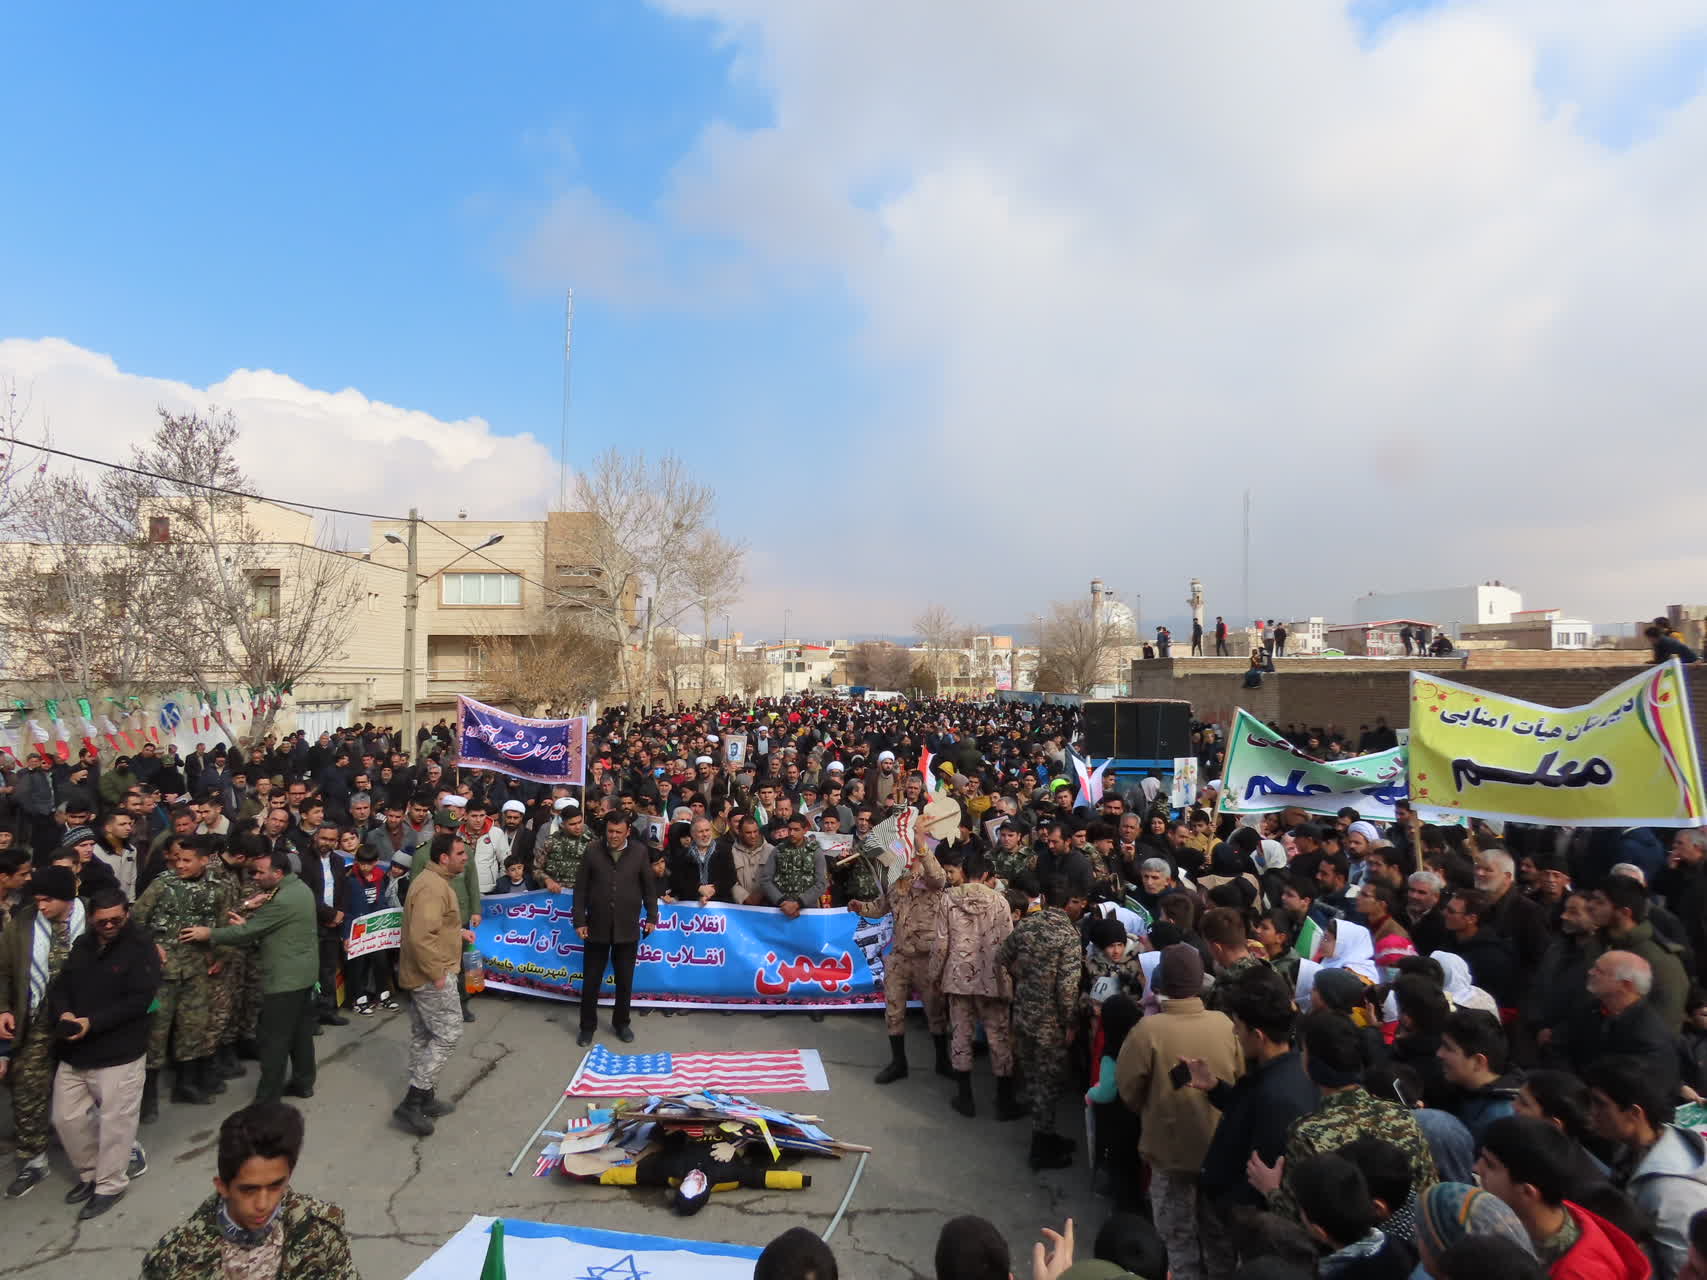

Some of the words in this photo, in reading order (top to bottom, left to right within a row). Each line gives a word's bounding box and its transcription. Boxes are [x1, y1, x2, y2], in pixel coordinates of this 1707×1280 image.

[1439, 706, 1509, 728] امنایی
[1566, 697, 1634, 741] دبیرستان
[1452, 750, 1613, 792] معلم
[680, 913, 726, 935] انقلاب
[535, 930, 560, 952] آن
[666, 945, 725, 967] انقلاب
[517, 963, 567, 979] شهرستان
[756, 952, 853, 995] بهمن
